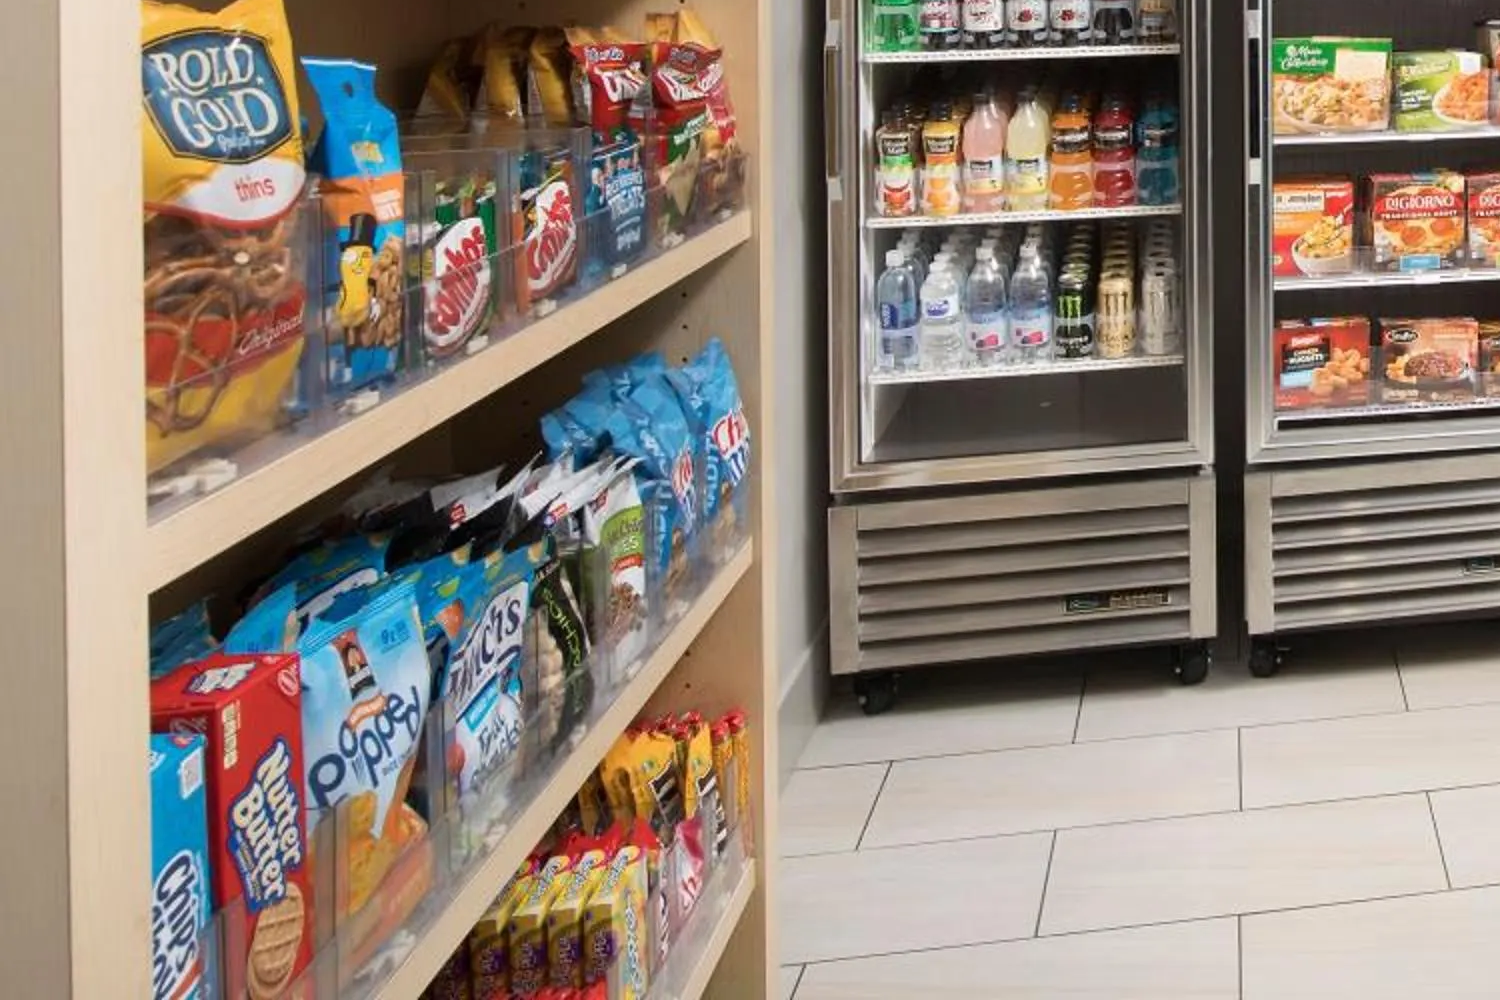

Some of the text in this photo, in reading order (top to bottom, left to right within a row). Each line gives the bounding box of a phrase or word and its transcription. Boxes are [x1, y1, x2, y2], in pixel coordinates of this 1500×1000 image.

[148, 37, 255, 97] ROLD
[170, 87, 280, 149] GOLD
[234, 174, 276, 203] thins
[232, 782, 286, 900] Butter
[256, 741, 301, 865] Nutter
[156, 854, 197, 973] Chips
